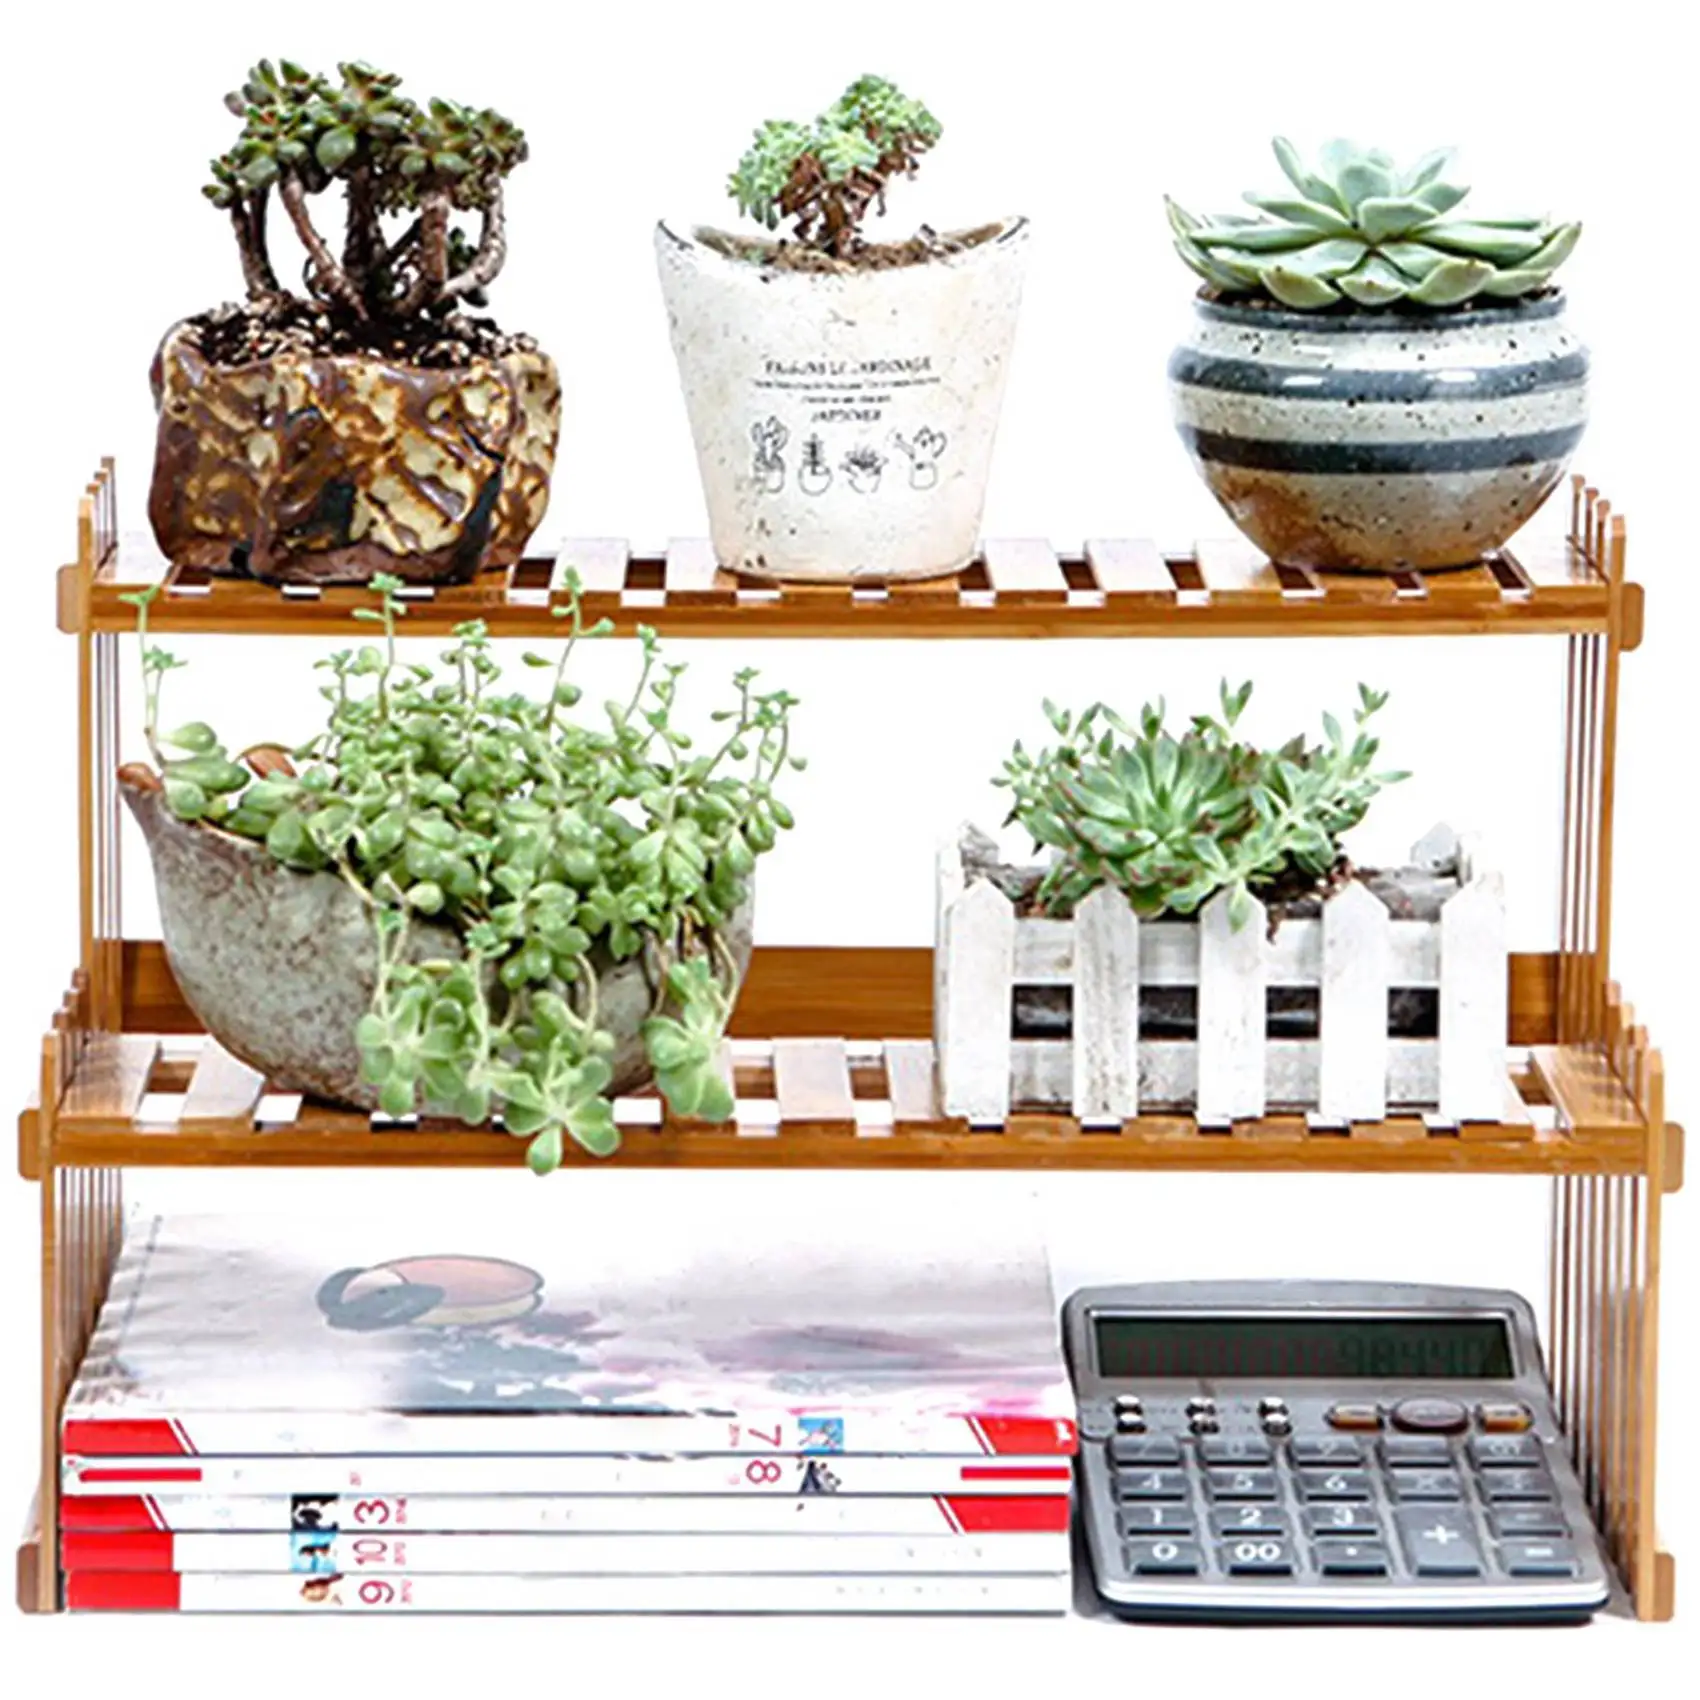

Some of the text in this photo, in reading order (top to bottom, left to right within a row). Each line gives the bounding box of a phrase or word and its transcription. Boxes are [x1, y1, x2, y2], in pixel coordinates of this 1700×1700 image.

[747, 1424, 781, 1448] 7
[745, 1459, 782, 1485] 8
[1141, 1473, 1163, 1490] 4
[1233, 1472, 1254, 1490] 5
[1325, 1473, 1348, 1491] 6
[353, 1499, 390, 1525] 3
[1239, 1506, 1262, 1526] 2
[1332, 1506, 1354, 1527] 3
[352, 1538, 388, 1566] 10
[1152, 1541, 1178, 1562] 0
[1233, 1541, 1281, 1563] 00
[358, 1580, 395, 1605] 9
